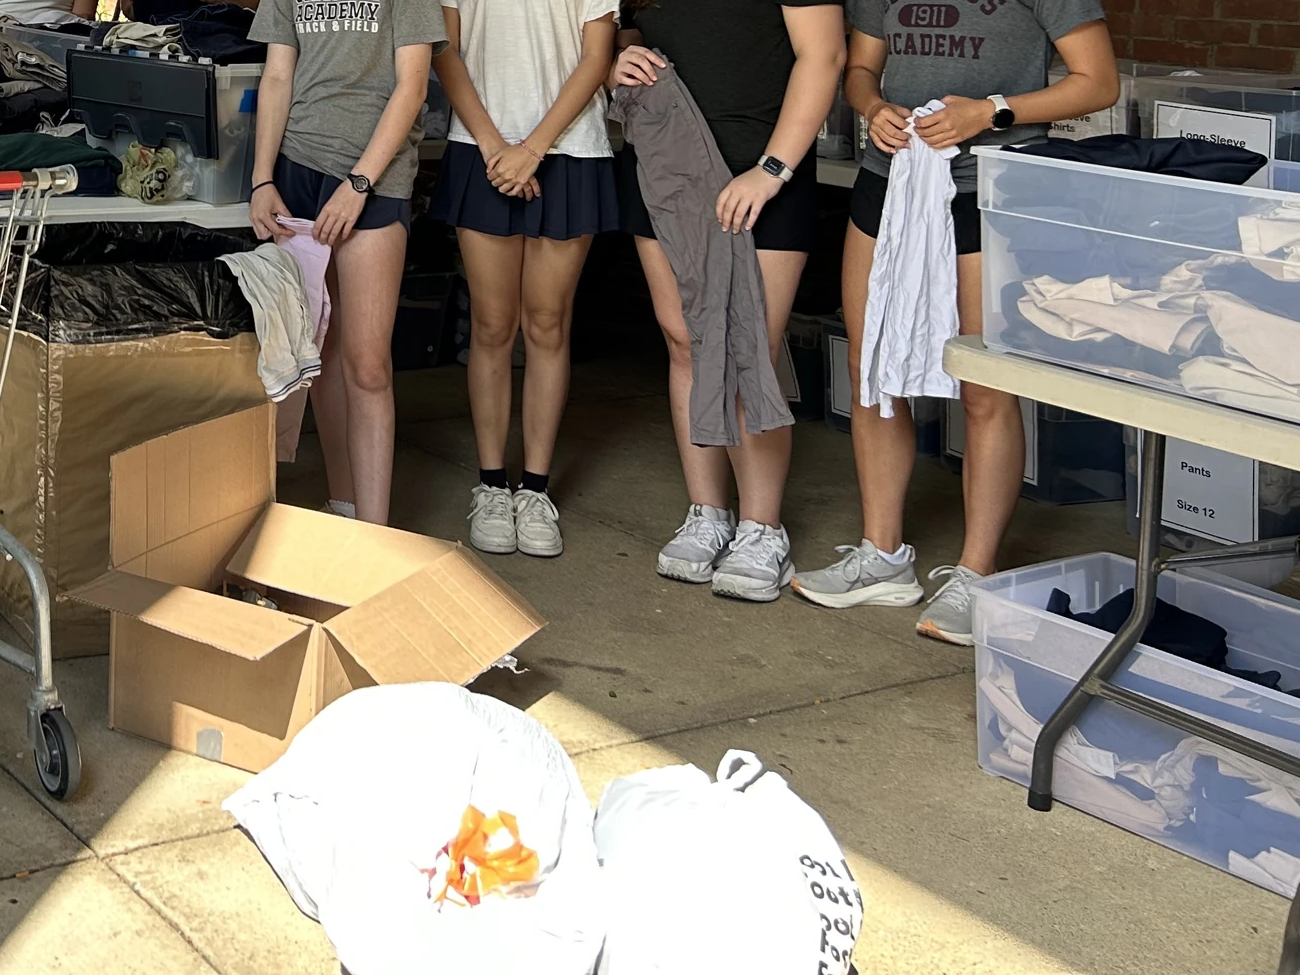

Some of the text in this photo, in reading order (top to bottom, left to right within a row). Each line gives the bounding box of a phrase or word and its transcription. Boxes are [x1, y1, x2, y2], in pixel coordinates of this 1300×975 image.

[295, 2, 380, 23] ACADEMY
[911, 6, 946, 25] 1911
[332, 20, 340, 32] &
[344, 19, 380, 33] FIELD
[1180, 461, 1211, 478] Pants
[1176, 499, 1215, 519] Size 12
